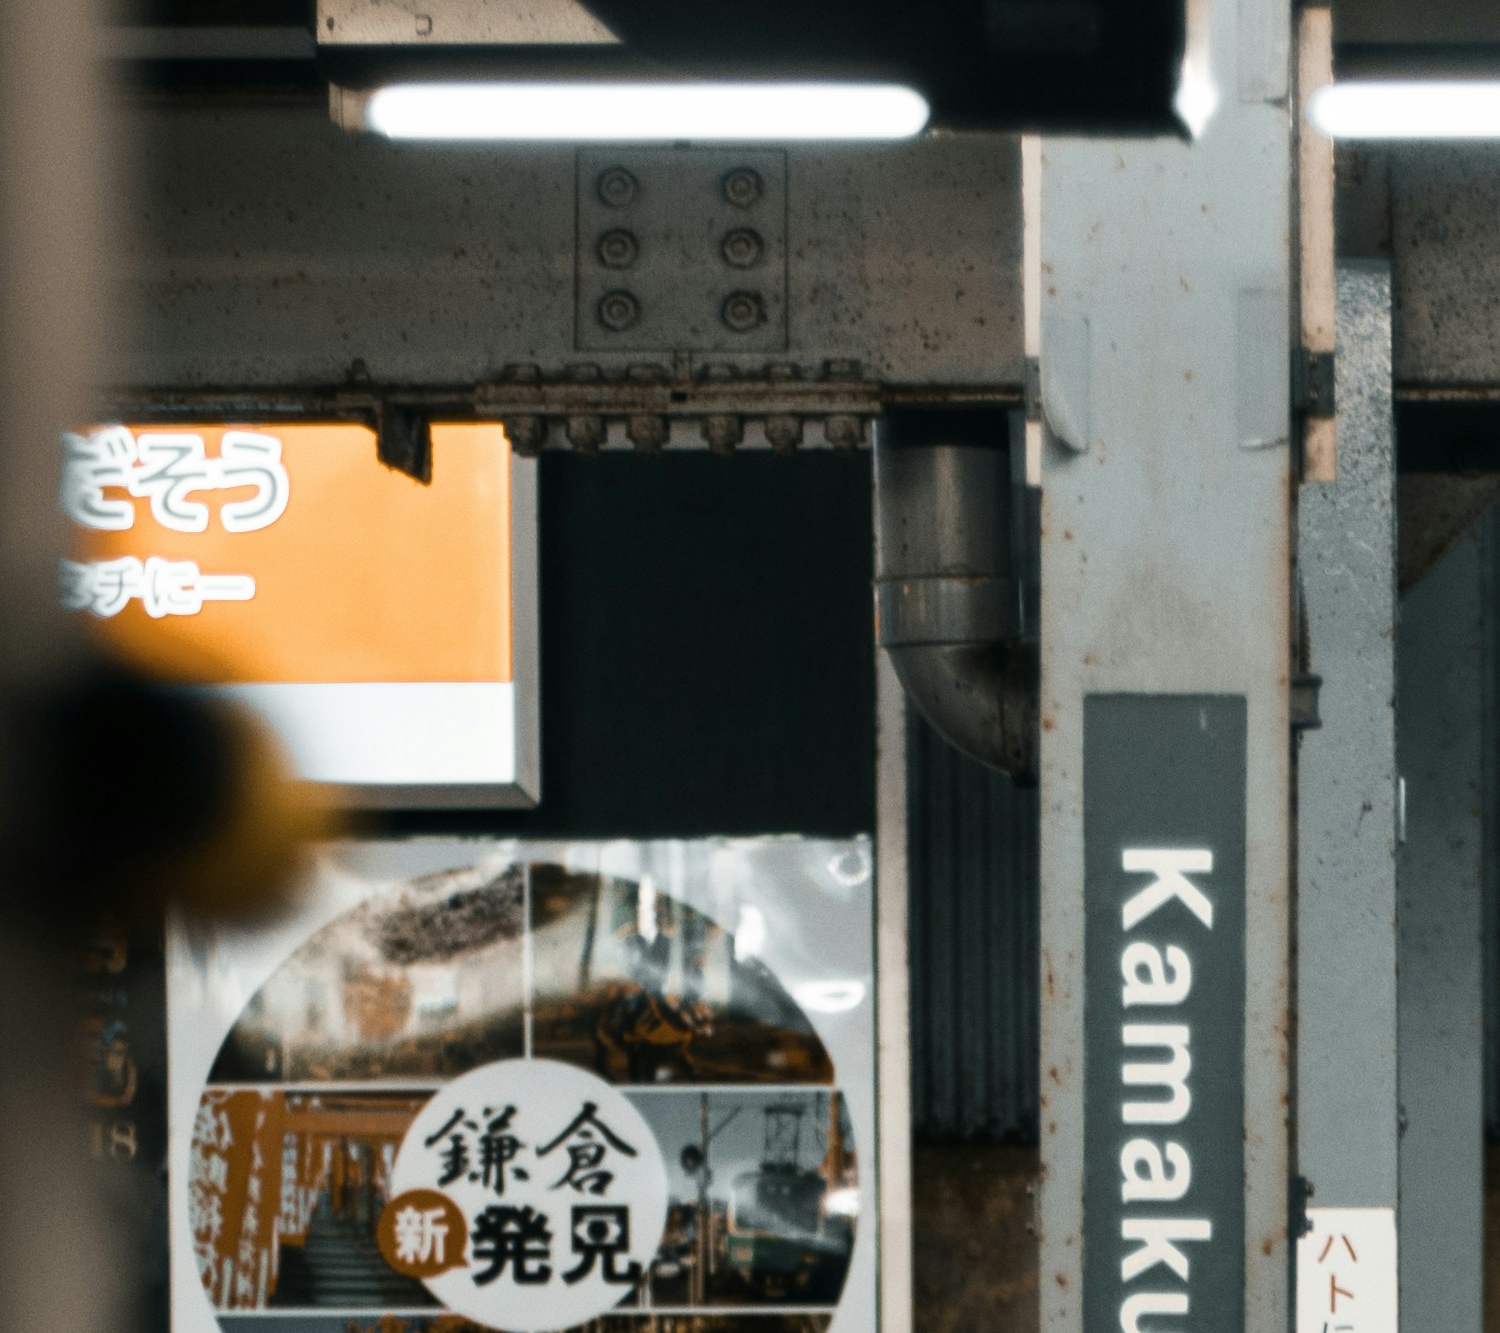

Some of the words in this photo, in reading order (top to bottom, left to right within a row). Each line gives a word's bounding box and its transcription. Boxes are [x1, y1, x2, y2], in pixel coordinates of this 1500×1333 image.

[424, 1101, 638, 1197] 鎌倉
[392, 1205, 450, 1266] 新
[469, 1204, 643, 1288] 発見
